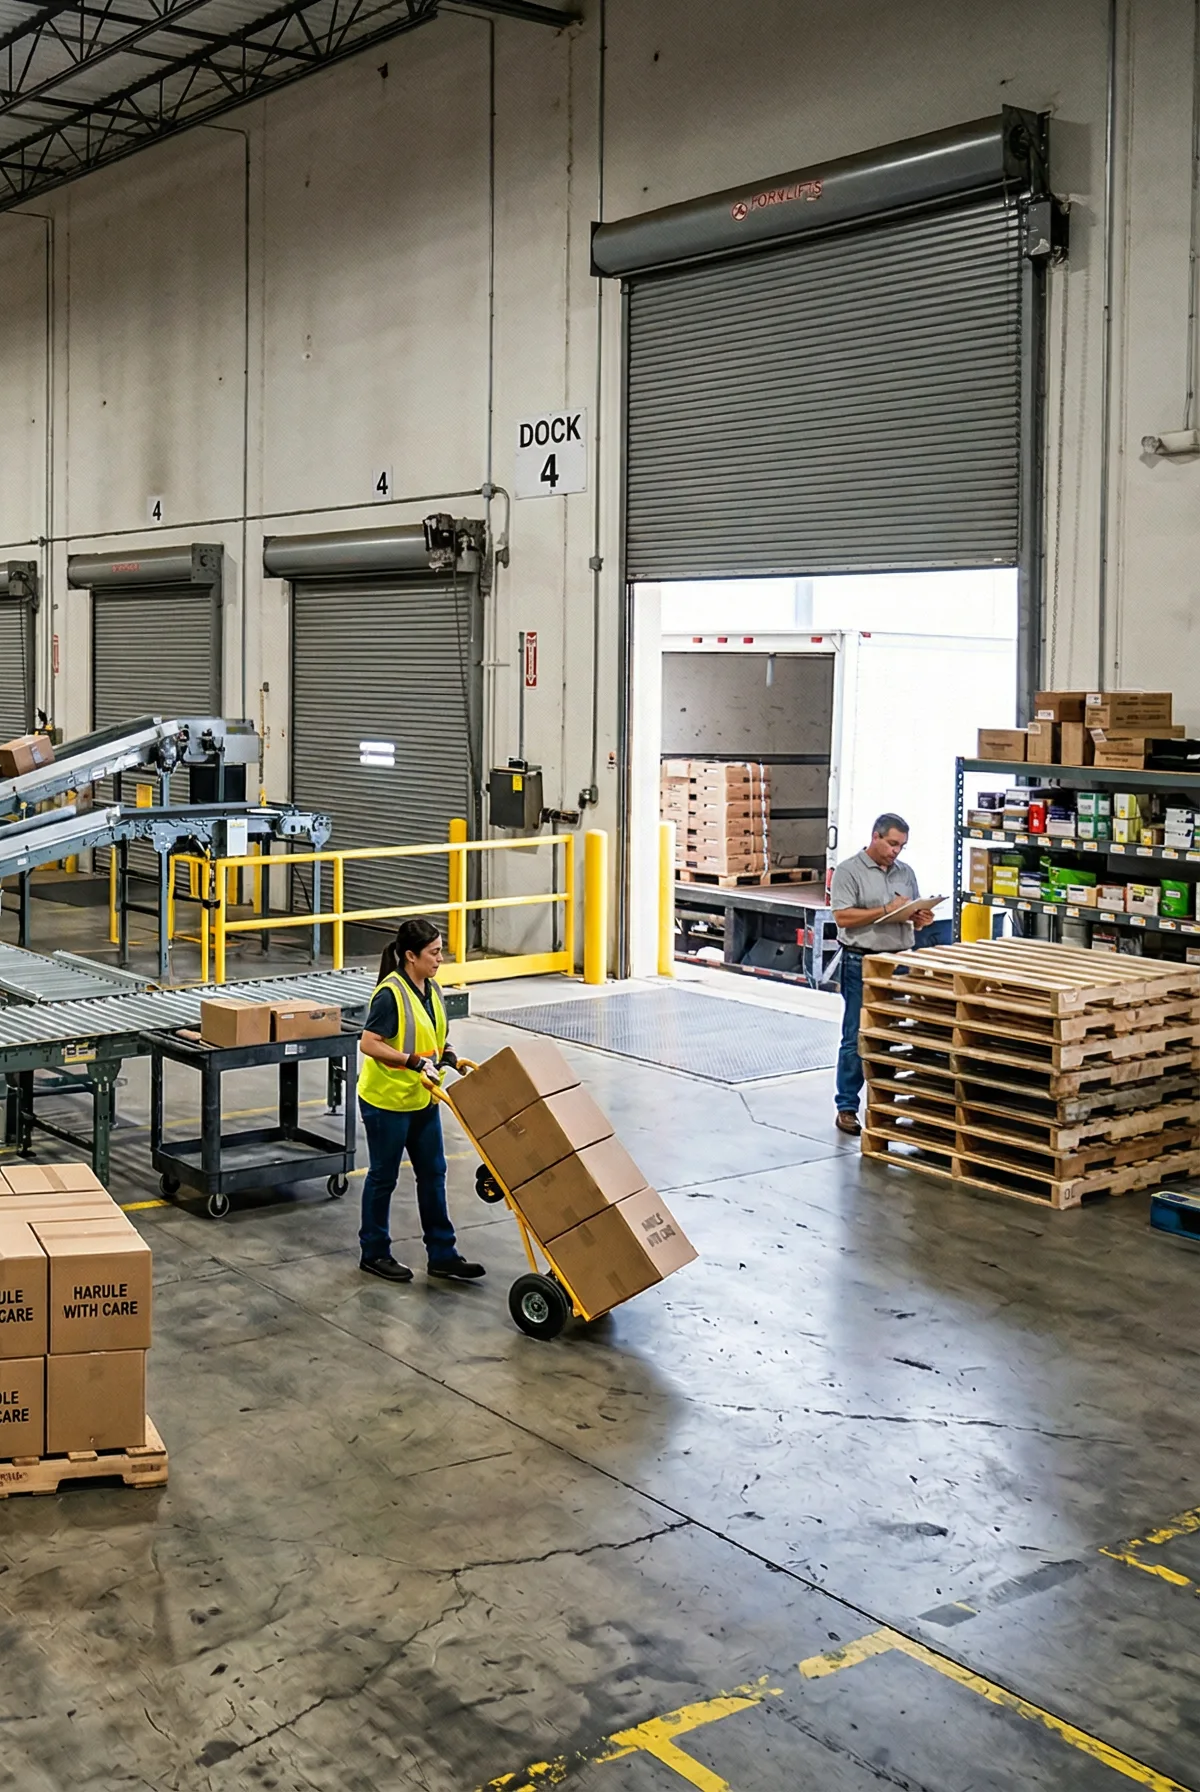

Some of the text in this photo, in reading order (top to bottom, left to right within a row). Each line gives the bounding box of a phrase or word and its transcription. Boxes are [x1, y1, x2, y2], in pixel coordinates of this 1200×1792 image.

[519, 413, 582, 449] DOCK
[540, 453, 560, 488] 4
[376, 471, 389, 495] 4
[152, 500, 162, 521] 4
[63, 1301, 138, 1319] WITH CARE
